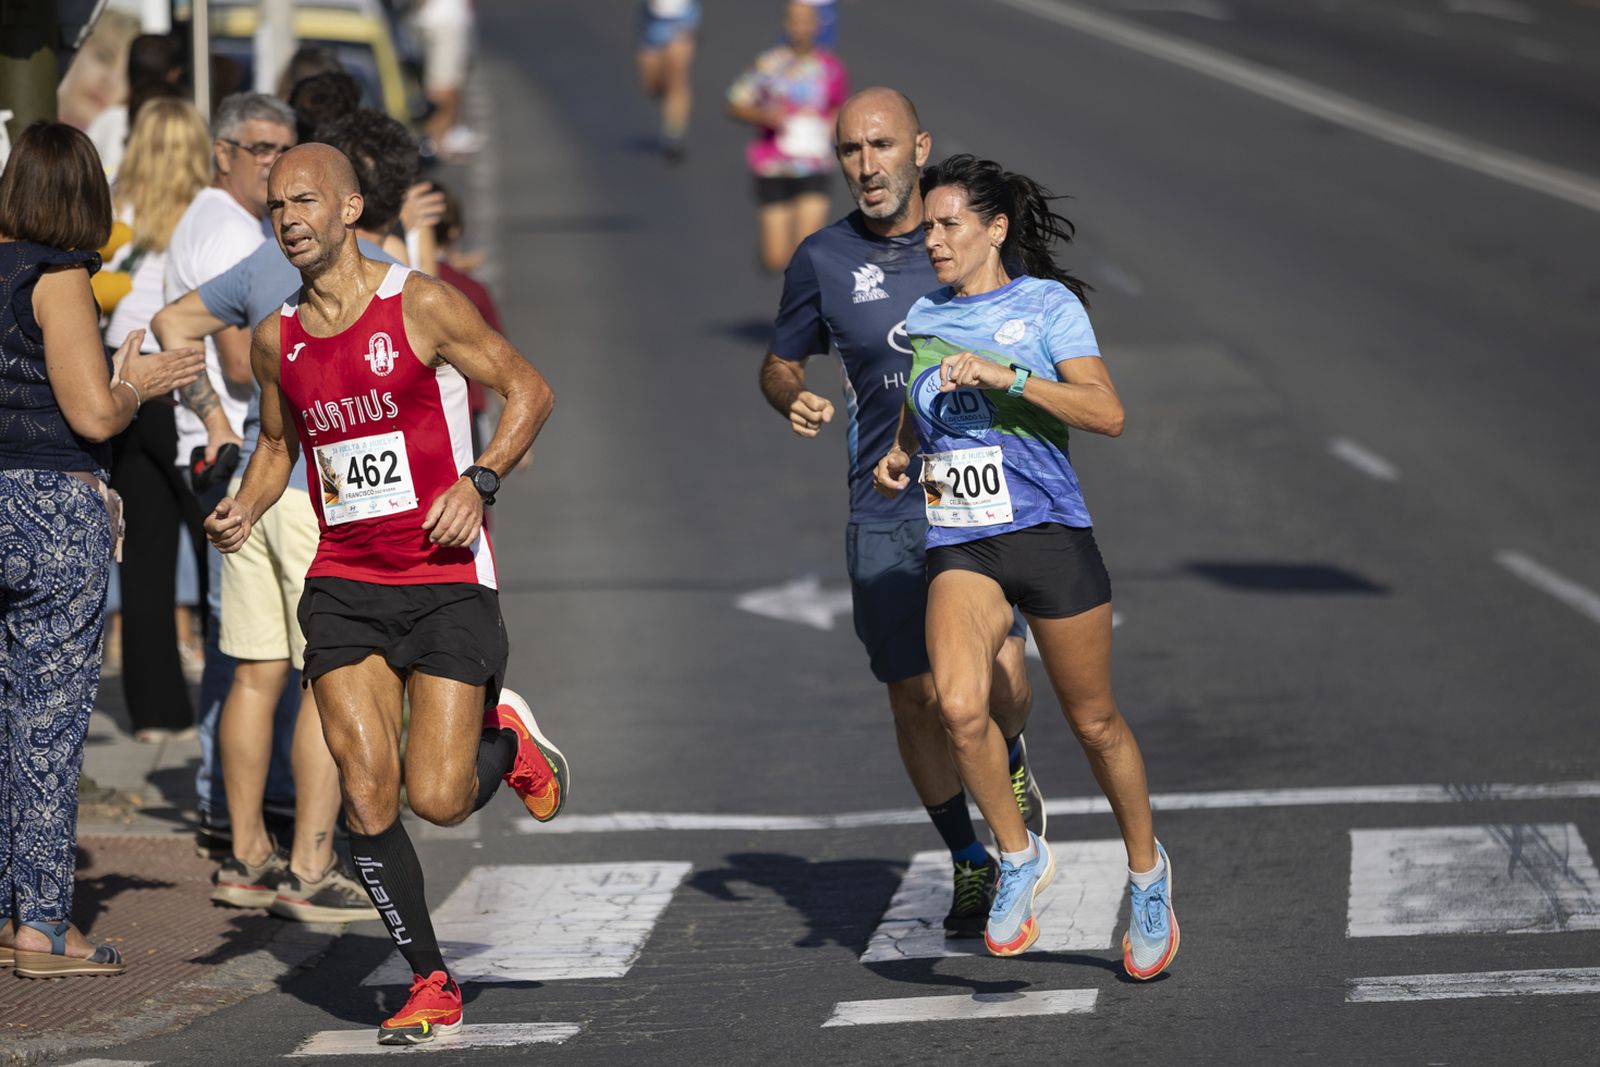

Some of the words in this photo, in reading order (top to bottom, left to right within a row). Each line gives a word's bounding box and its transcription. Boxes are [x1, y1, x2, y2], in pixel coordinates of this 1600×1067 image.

[302, 389, 399, 436] CURTIUS
[947, 391, 979, 415] JD
[347, 450, 402, 489] 462
[947, 463, 1000, 498] 200
[345, 490, 375, 499] FRANCISCO
